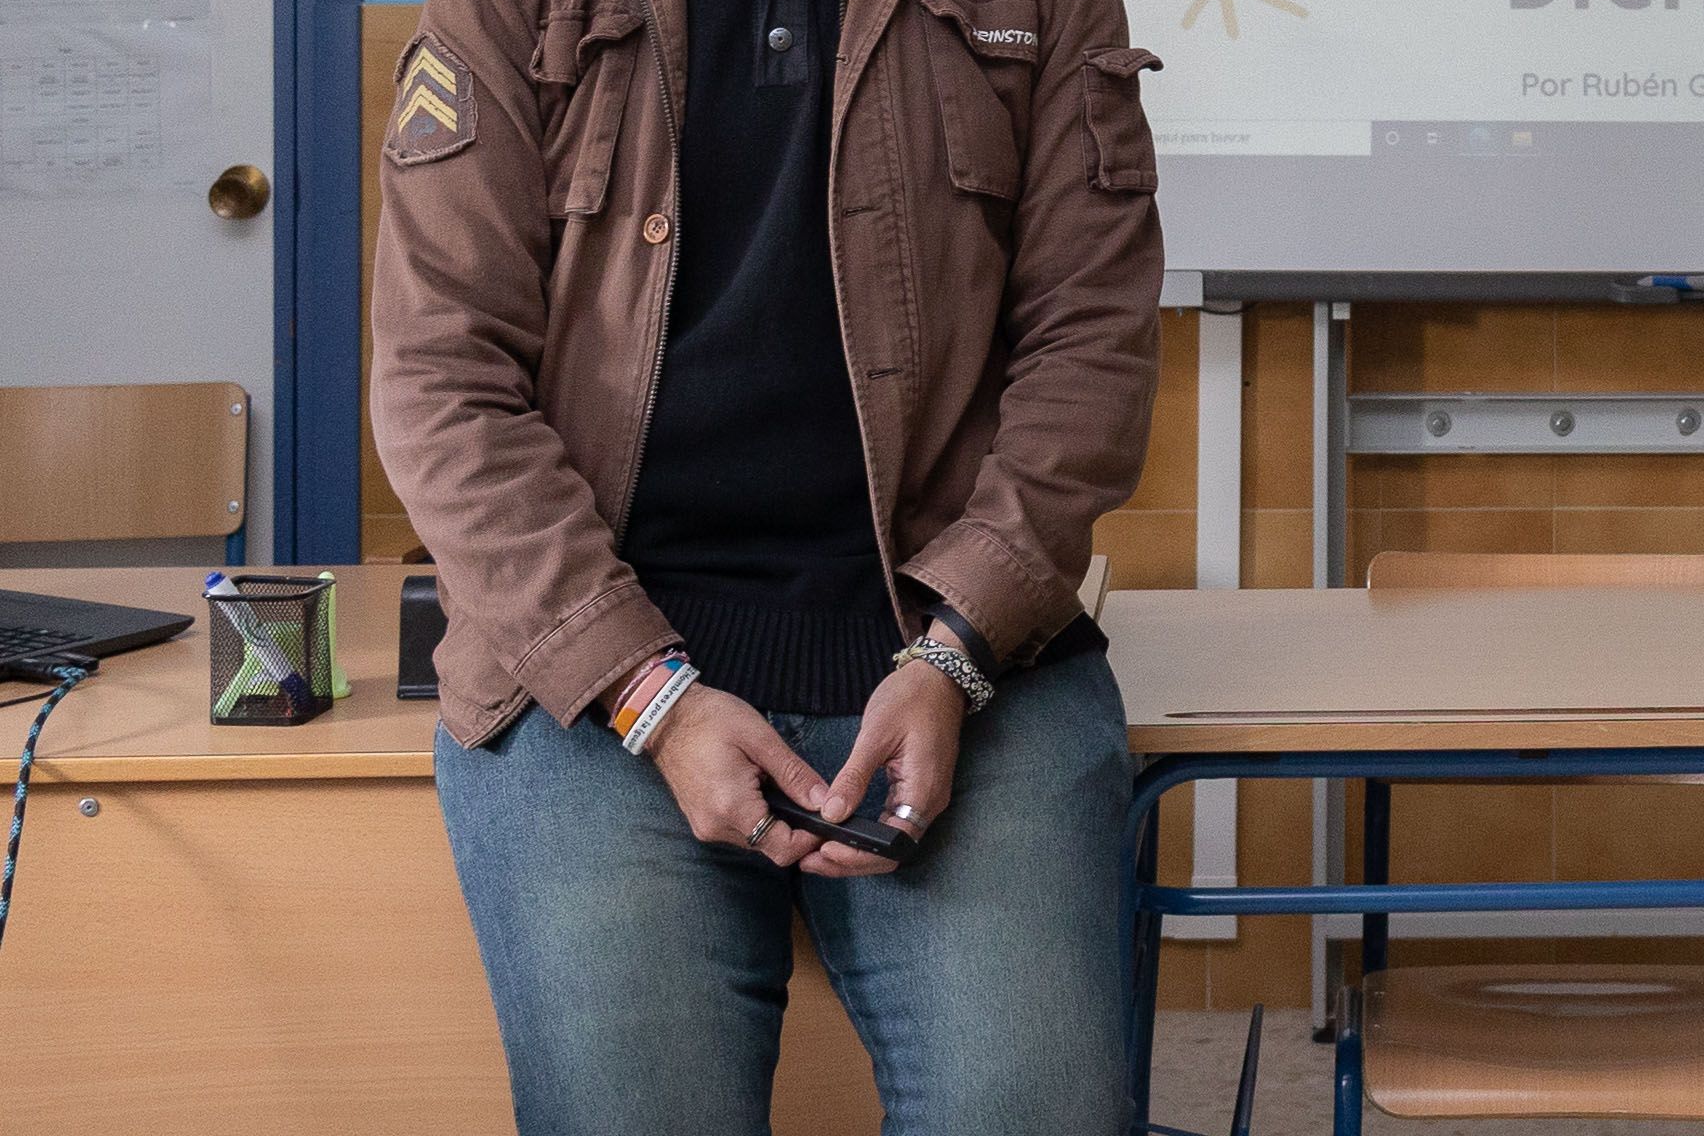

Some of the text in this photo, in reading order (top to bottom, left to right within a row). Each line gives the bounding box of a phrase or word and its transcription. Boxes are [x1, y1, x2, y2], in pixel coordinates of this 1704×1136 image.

[1521, 73, 1573, 99] Por
[1582, 72, 1678, 99] Rubén
[648, 703, 662, 721] por
